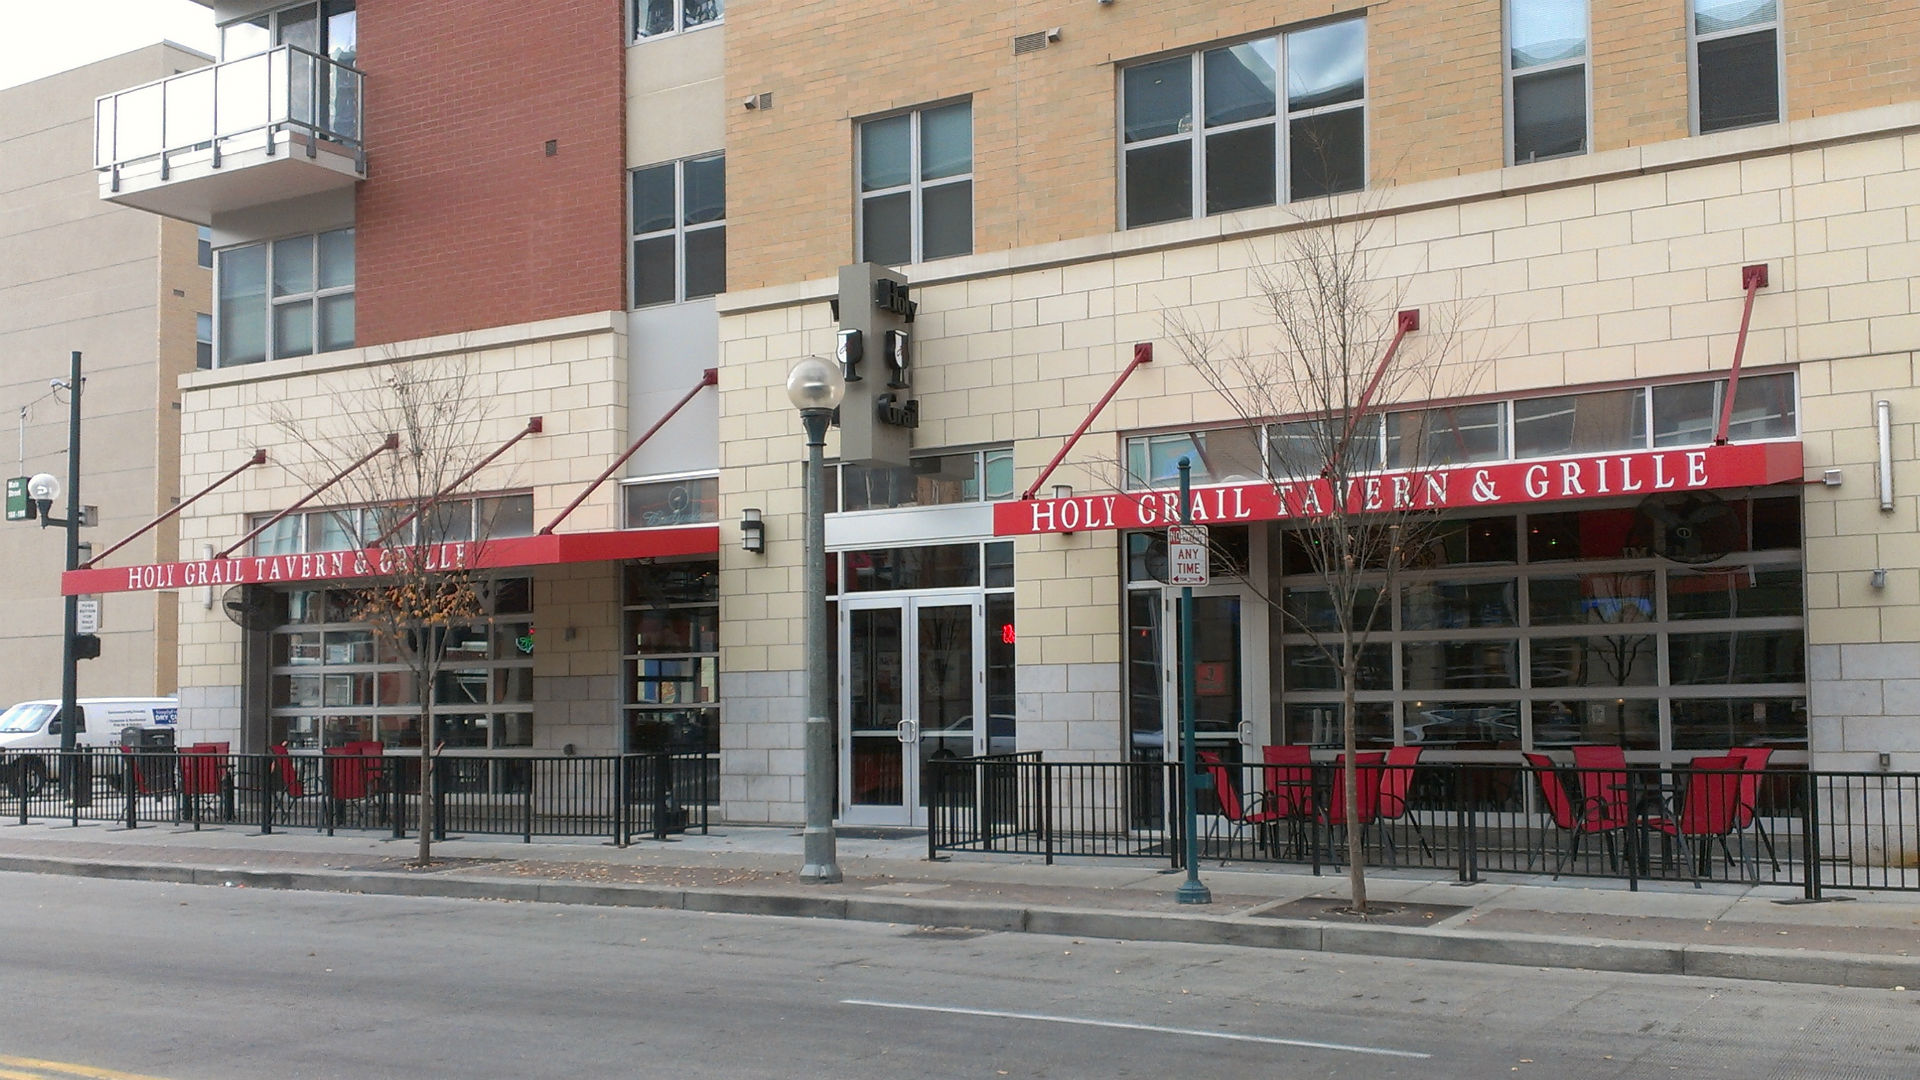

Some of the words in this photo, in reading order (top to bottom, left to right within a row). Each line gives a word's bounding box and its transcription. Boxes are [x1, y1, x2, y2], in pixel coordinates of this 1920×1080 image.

[878, 278, 918, 323] Holy
[878, 392, 919, 428] Grail
[1031, 497, 1116, 531] HOLY
[1138, 487, 1251, 524] GRAIL
[1272, 472, 1449, 516] TAVERN
[1471, 469, 1501, 502] &
[1525, 451, 1709, 499] GRILLE
[128, 564, 175, 589] HOLY
[184, 559, 244, 585] GRAIL
[255, 552, 344, 581] TAVERN
[353, 551, 368, 575] &
[1177, 548, 1199, 559] ANY
[1177, 562, 1201, 574] TIME
